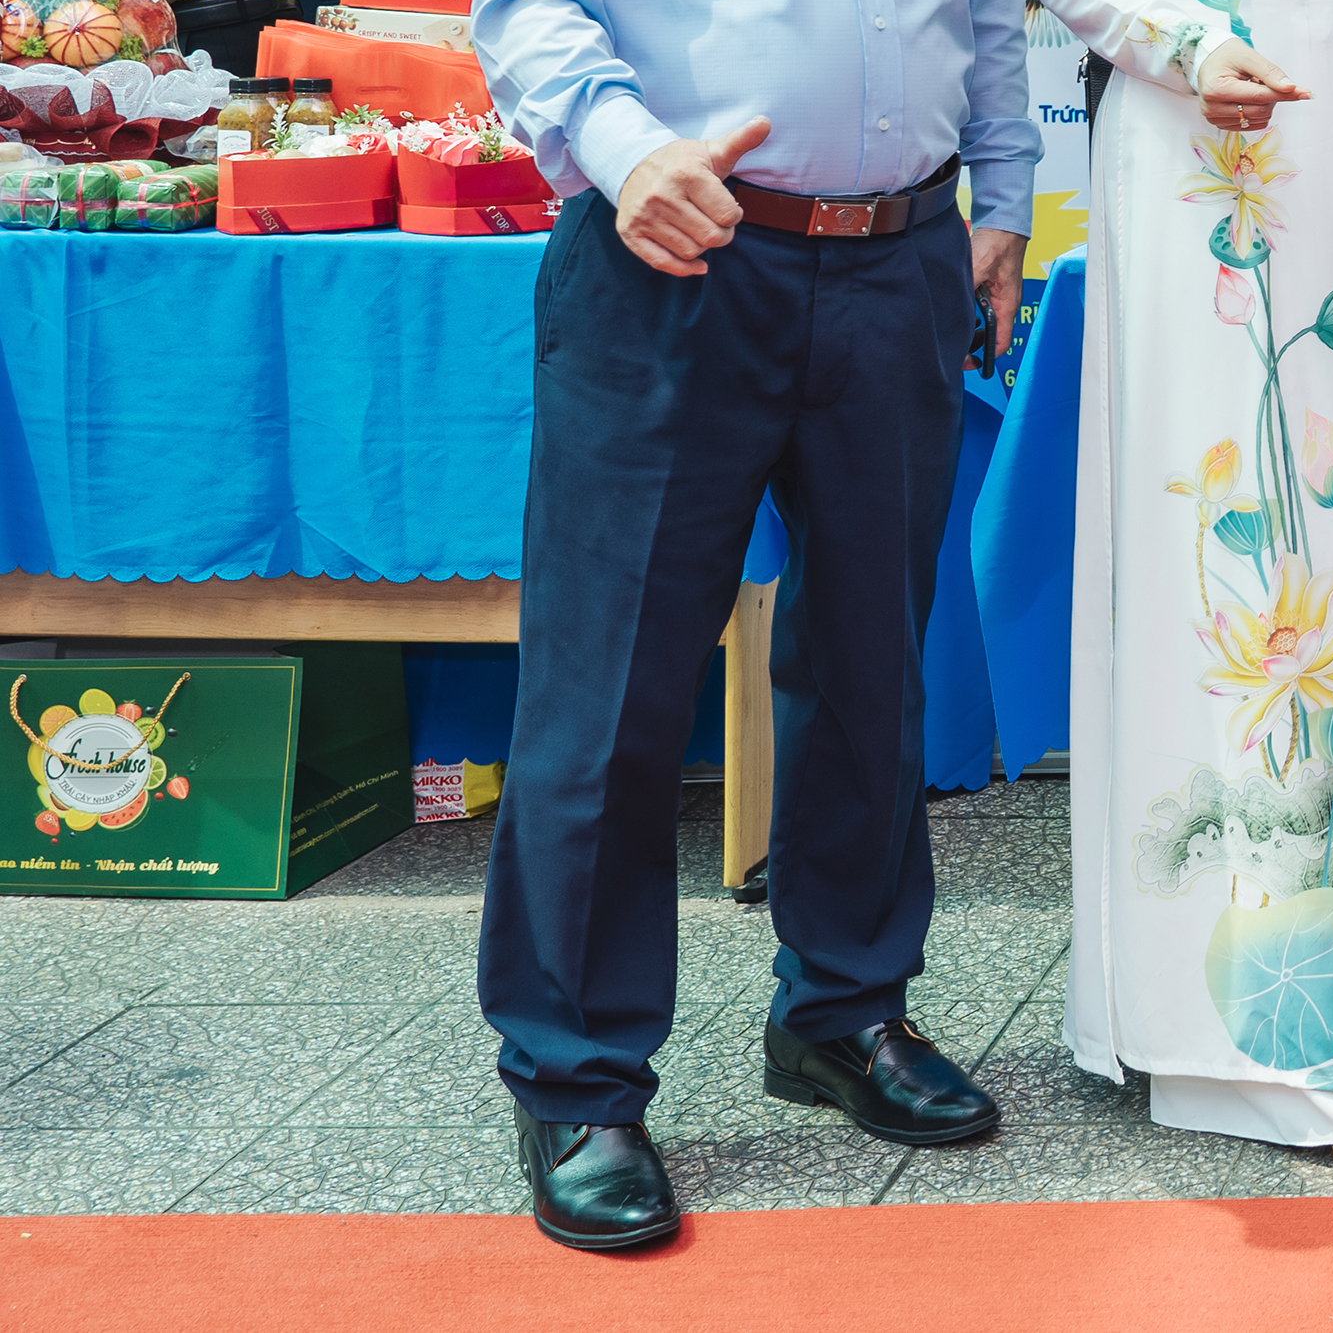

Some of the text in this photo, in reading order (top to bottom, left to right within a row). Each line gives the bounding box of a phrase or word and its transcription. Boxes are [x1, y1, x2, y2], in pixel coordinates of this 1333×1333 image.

[358, 29, 381, 38] CRISPY
[399, 32, 422, 41] SWEET
[1038, 104, 1088, 124] Trứn
[257, 206, 280, 232] JUST
[412, 775, 462, 787] MIKKO
[415, 793, 463, 806] MIKKO
[20, 856, 57, 871] niềm
[60, 858, 81, 871] tin
[94, 859, 136, 874] Nhận
[139, 856, 174, 872] chất
[176, 859, 220, 875] lượng
